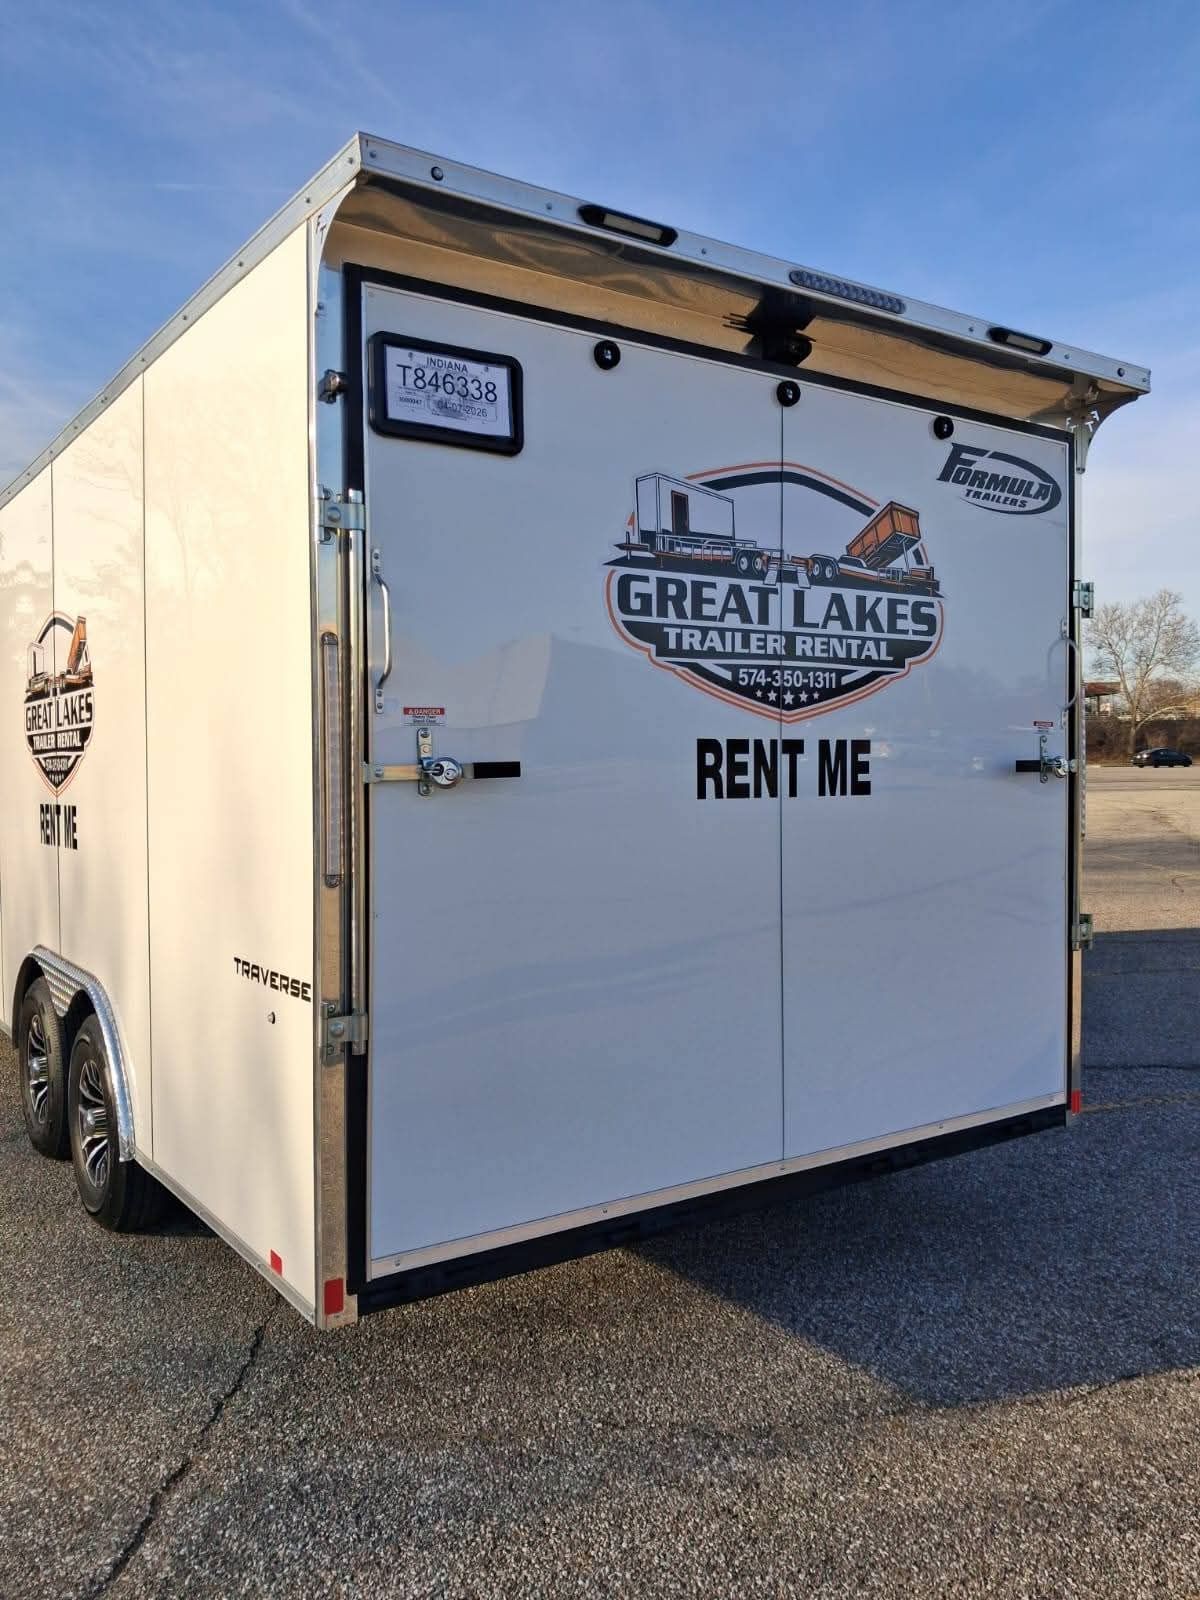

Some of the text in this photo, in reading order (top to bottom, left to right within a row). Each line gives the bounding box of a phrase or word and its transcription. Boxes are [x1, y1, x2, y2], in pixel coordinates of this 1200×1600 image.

[396, 363, 498, 403] T846338
[426, 356, 468, 374] INDIANA
[436, 399, 488, 418] 04-07-2026
[936, 442, 1052, 502] FORMULA
[965, 488, 1029, 509] TRAILERS
[617, 573, 938, 637] GREAT LAKES
[662, 626, 894, 661] TRAILER RENTAL
[738, 668, 837, 689] 574-350-1311
[25, 691, 93, 732] GREAT LAKES
[696, 738, 872, 800] RENT ME
[39, 803, 78, 850] RENT ME
[233, 956, 312, 1003] TRAVERSE
